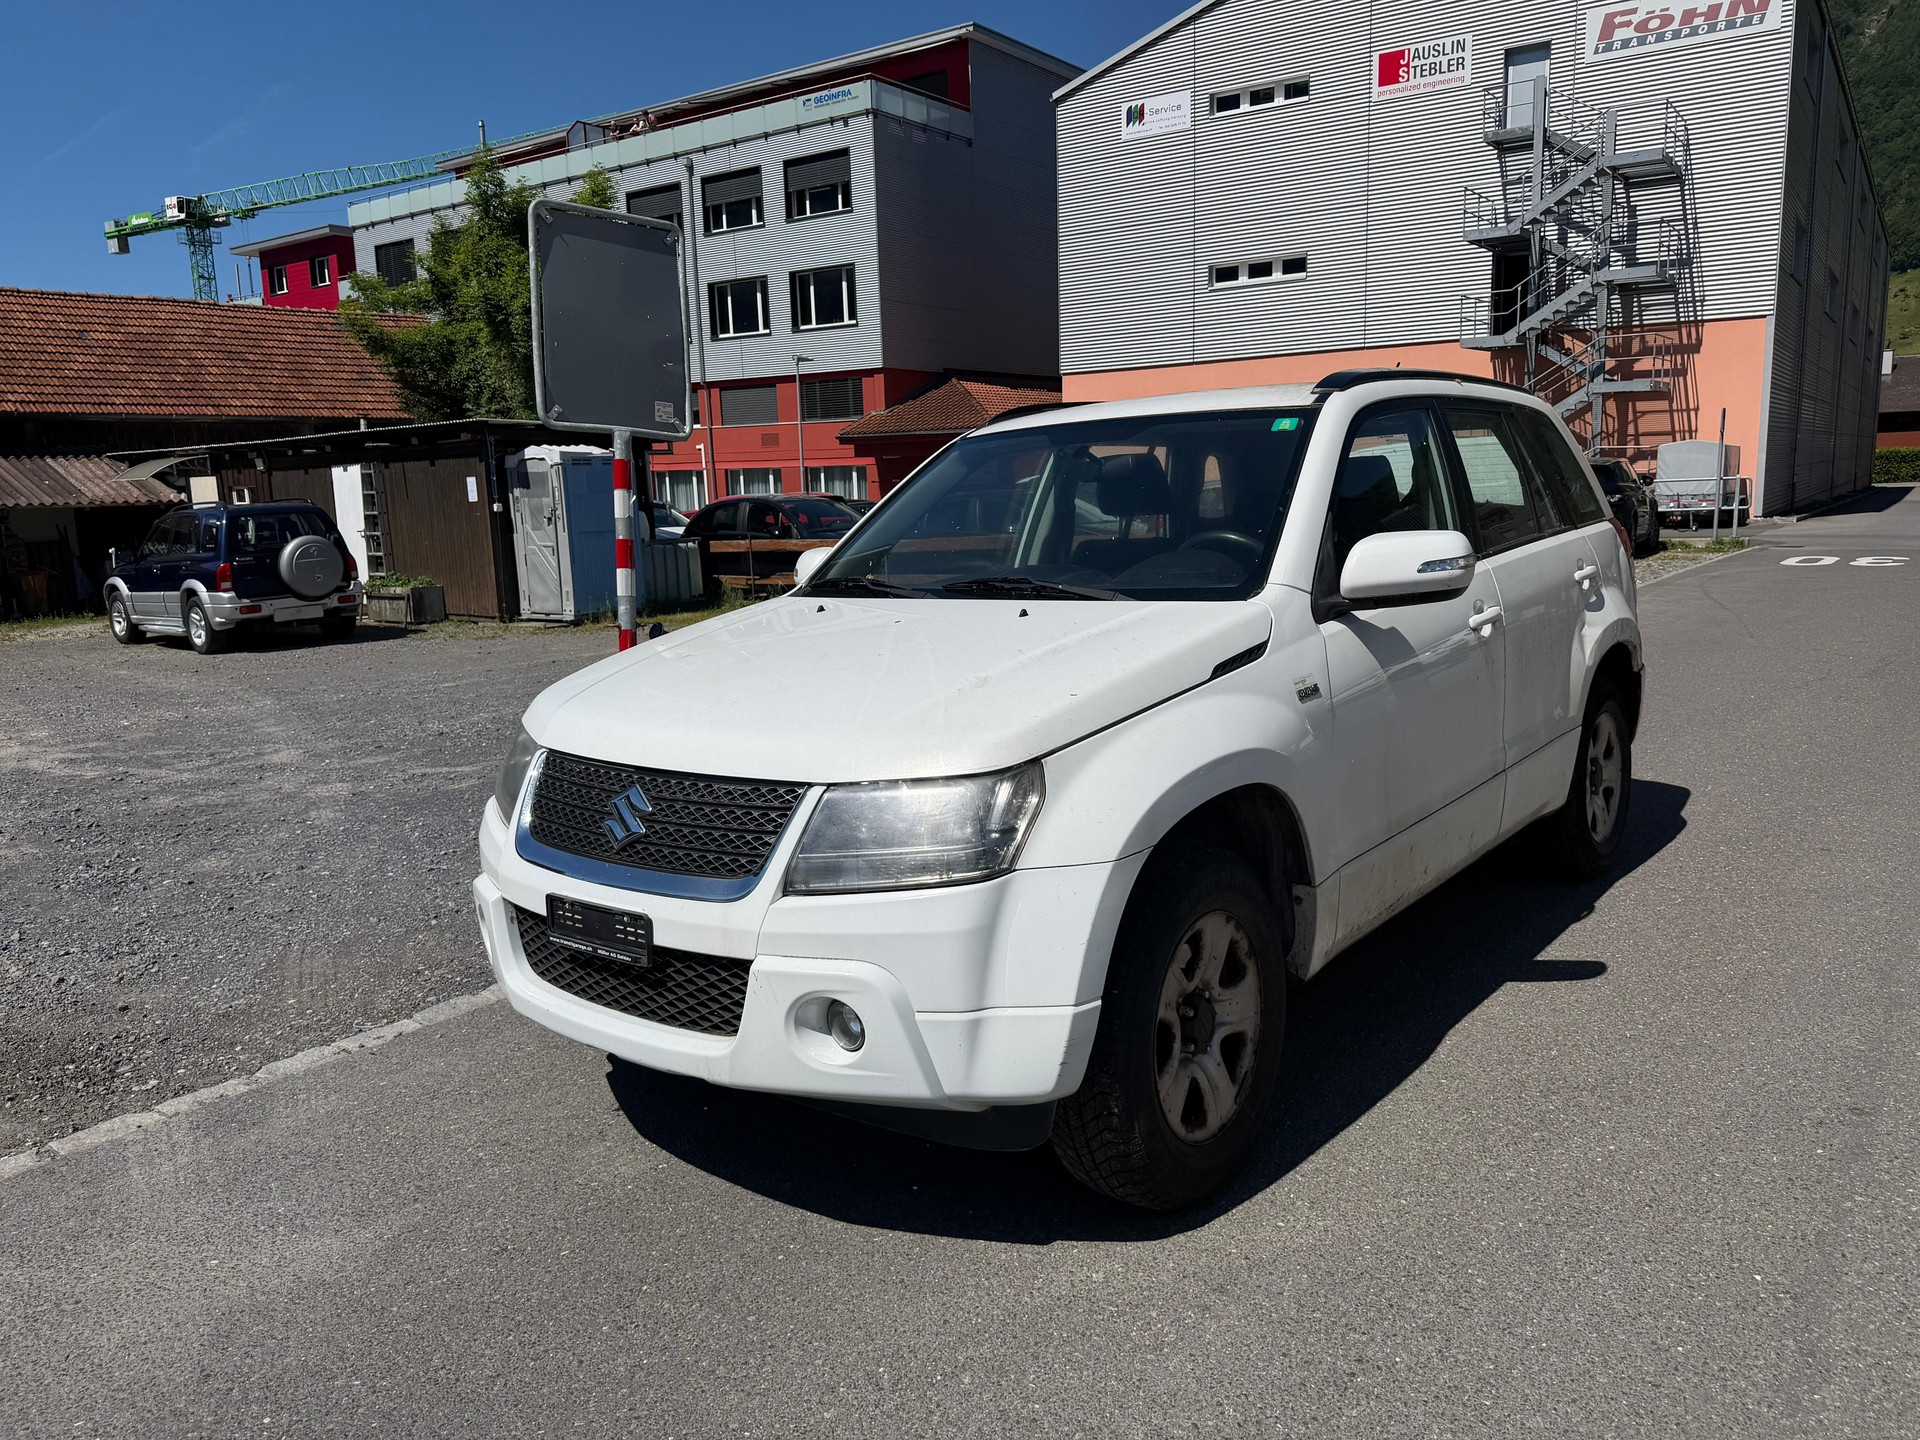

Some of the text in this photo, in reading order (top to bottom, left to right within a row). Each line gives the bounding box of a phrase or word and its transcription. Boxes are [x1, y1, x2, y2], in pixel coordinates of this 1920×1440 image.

[1597, 14, 1763, 53] TRANSPORTE
[1398, 56, 1465, 83] STEBLER
[813, 89, 852, 104] GEOINFRA
[1377, 75, 1465, 98] personalized engineering
